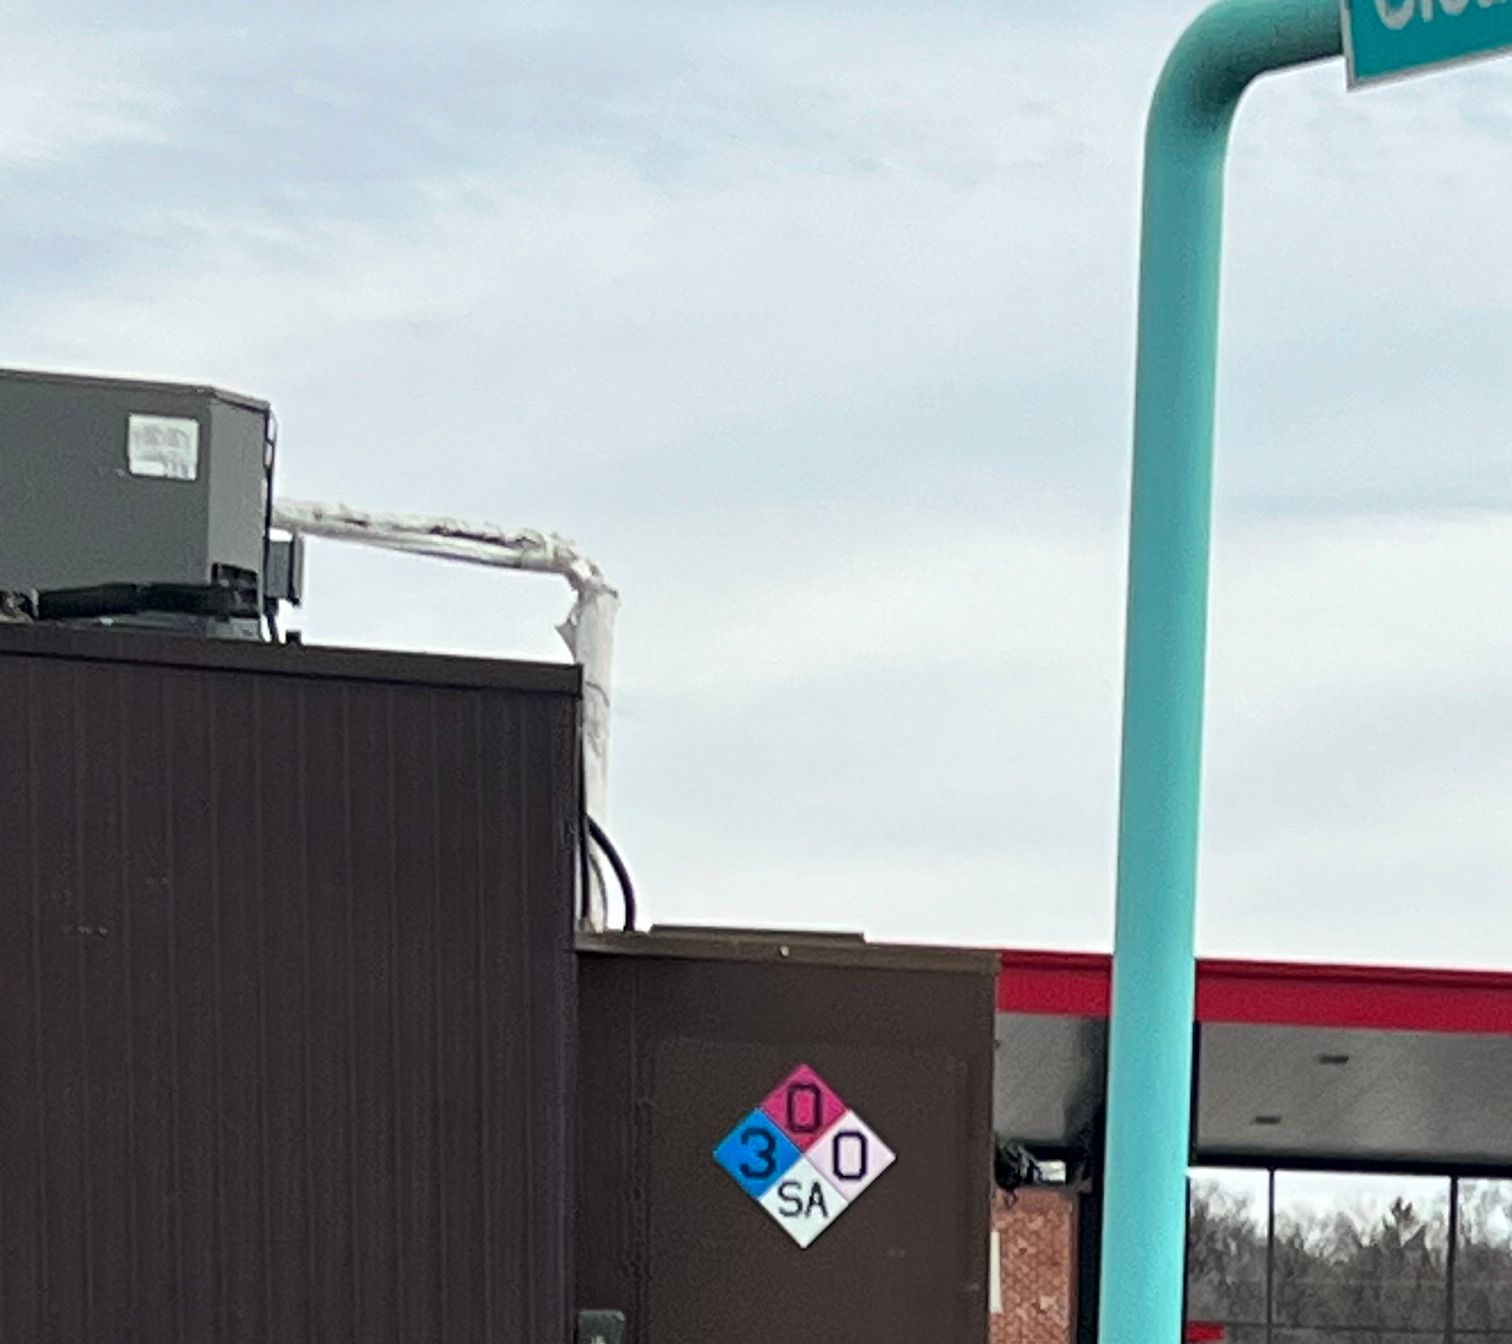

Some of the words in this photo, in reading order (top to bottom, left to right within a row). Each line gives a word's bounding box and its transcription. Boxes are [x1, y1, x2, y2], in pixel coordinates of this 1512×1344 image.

[788, 1084, 822, 1133] 0
[739, 1128, 776, 1179] 3
[833, 1131, 867, 1180] 0
[777, 1180, 829, 1218] SA
